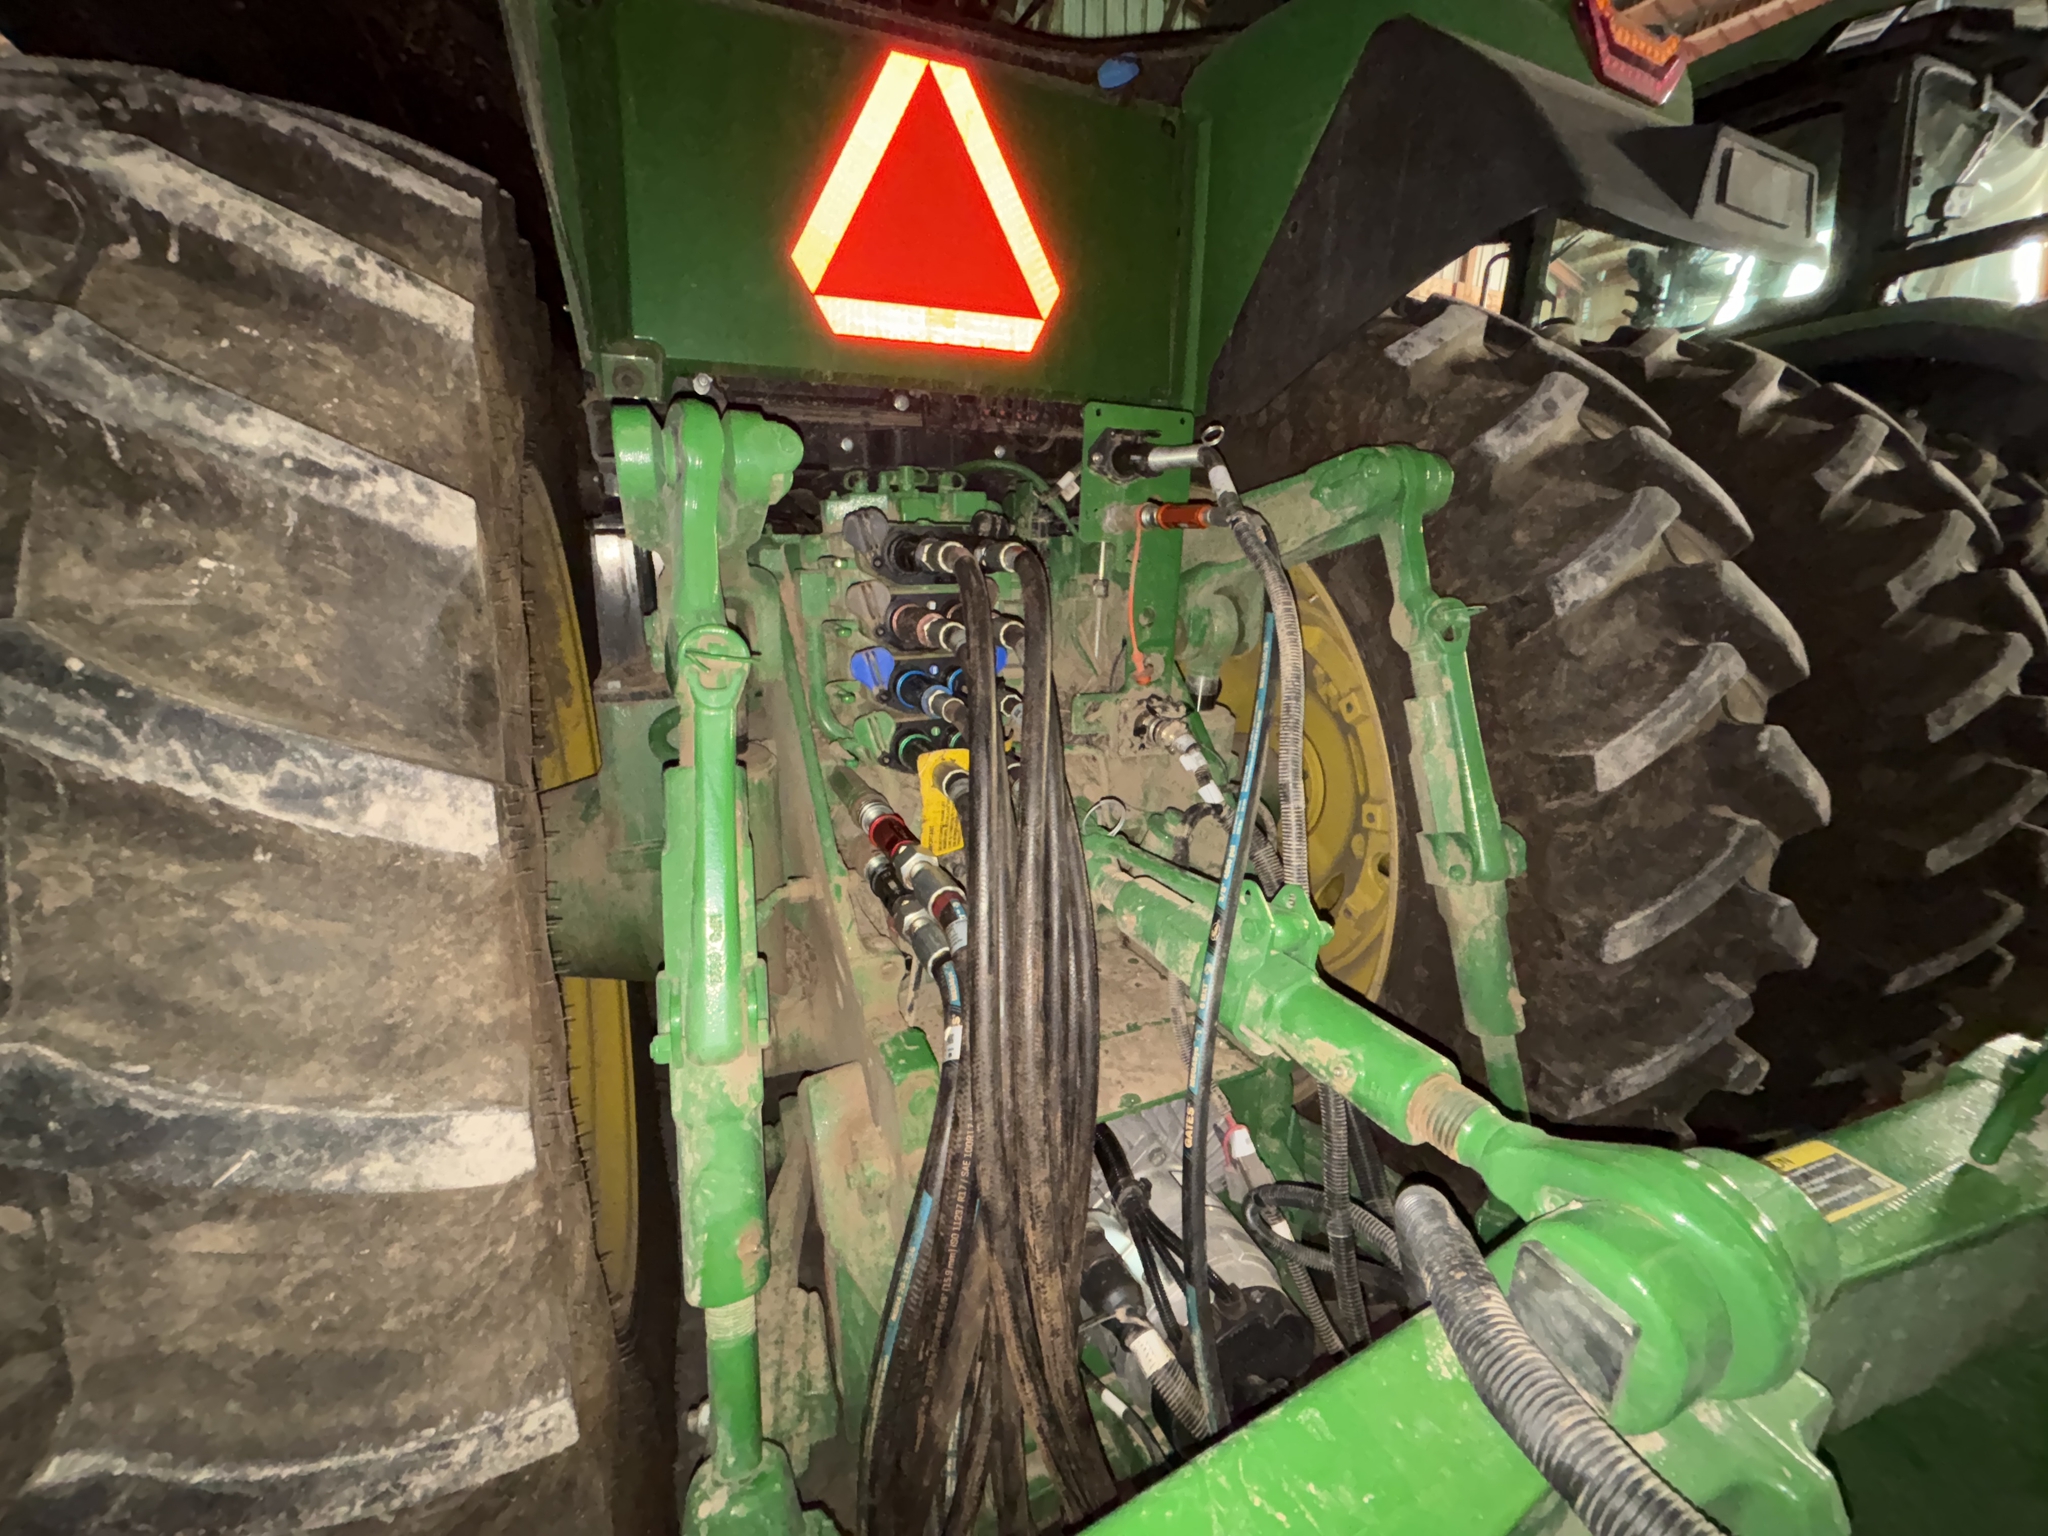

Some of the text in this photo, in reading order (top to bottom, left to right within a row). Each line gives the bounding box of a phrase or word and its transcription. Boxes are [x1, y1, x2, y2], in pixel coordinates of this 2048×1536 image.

[963, 1124, 974, 1157] 100R17
[1185, 1107, 1195, 1148] GATES
[961, 1159, 971, 1177] SAE
[957, 1185, 967, 1203] R17
[953, 1204, 964, 1231] 11237
